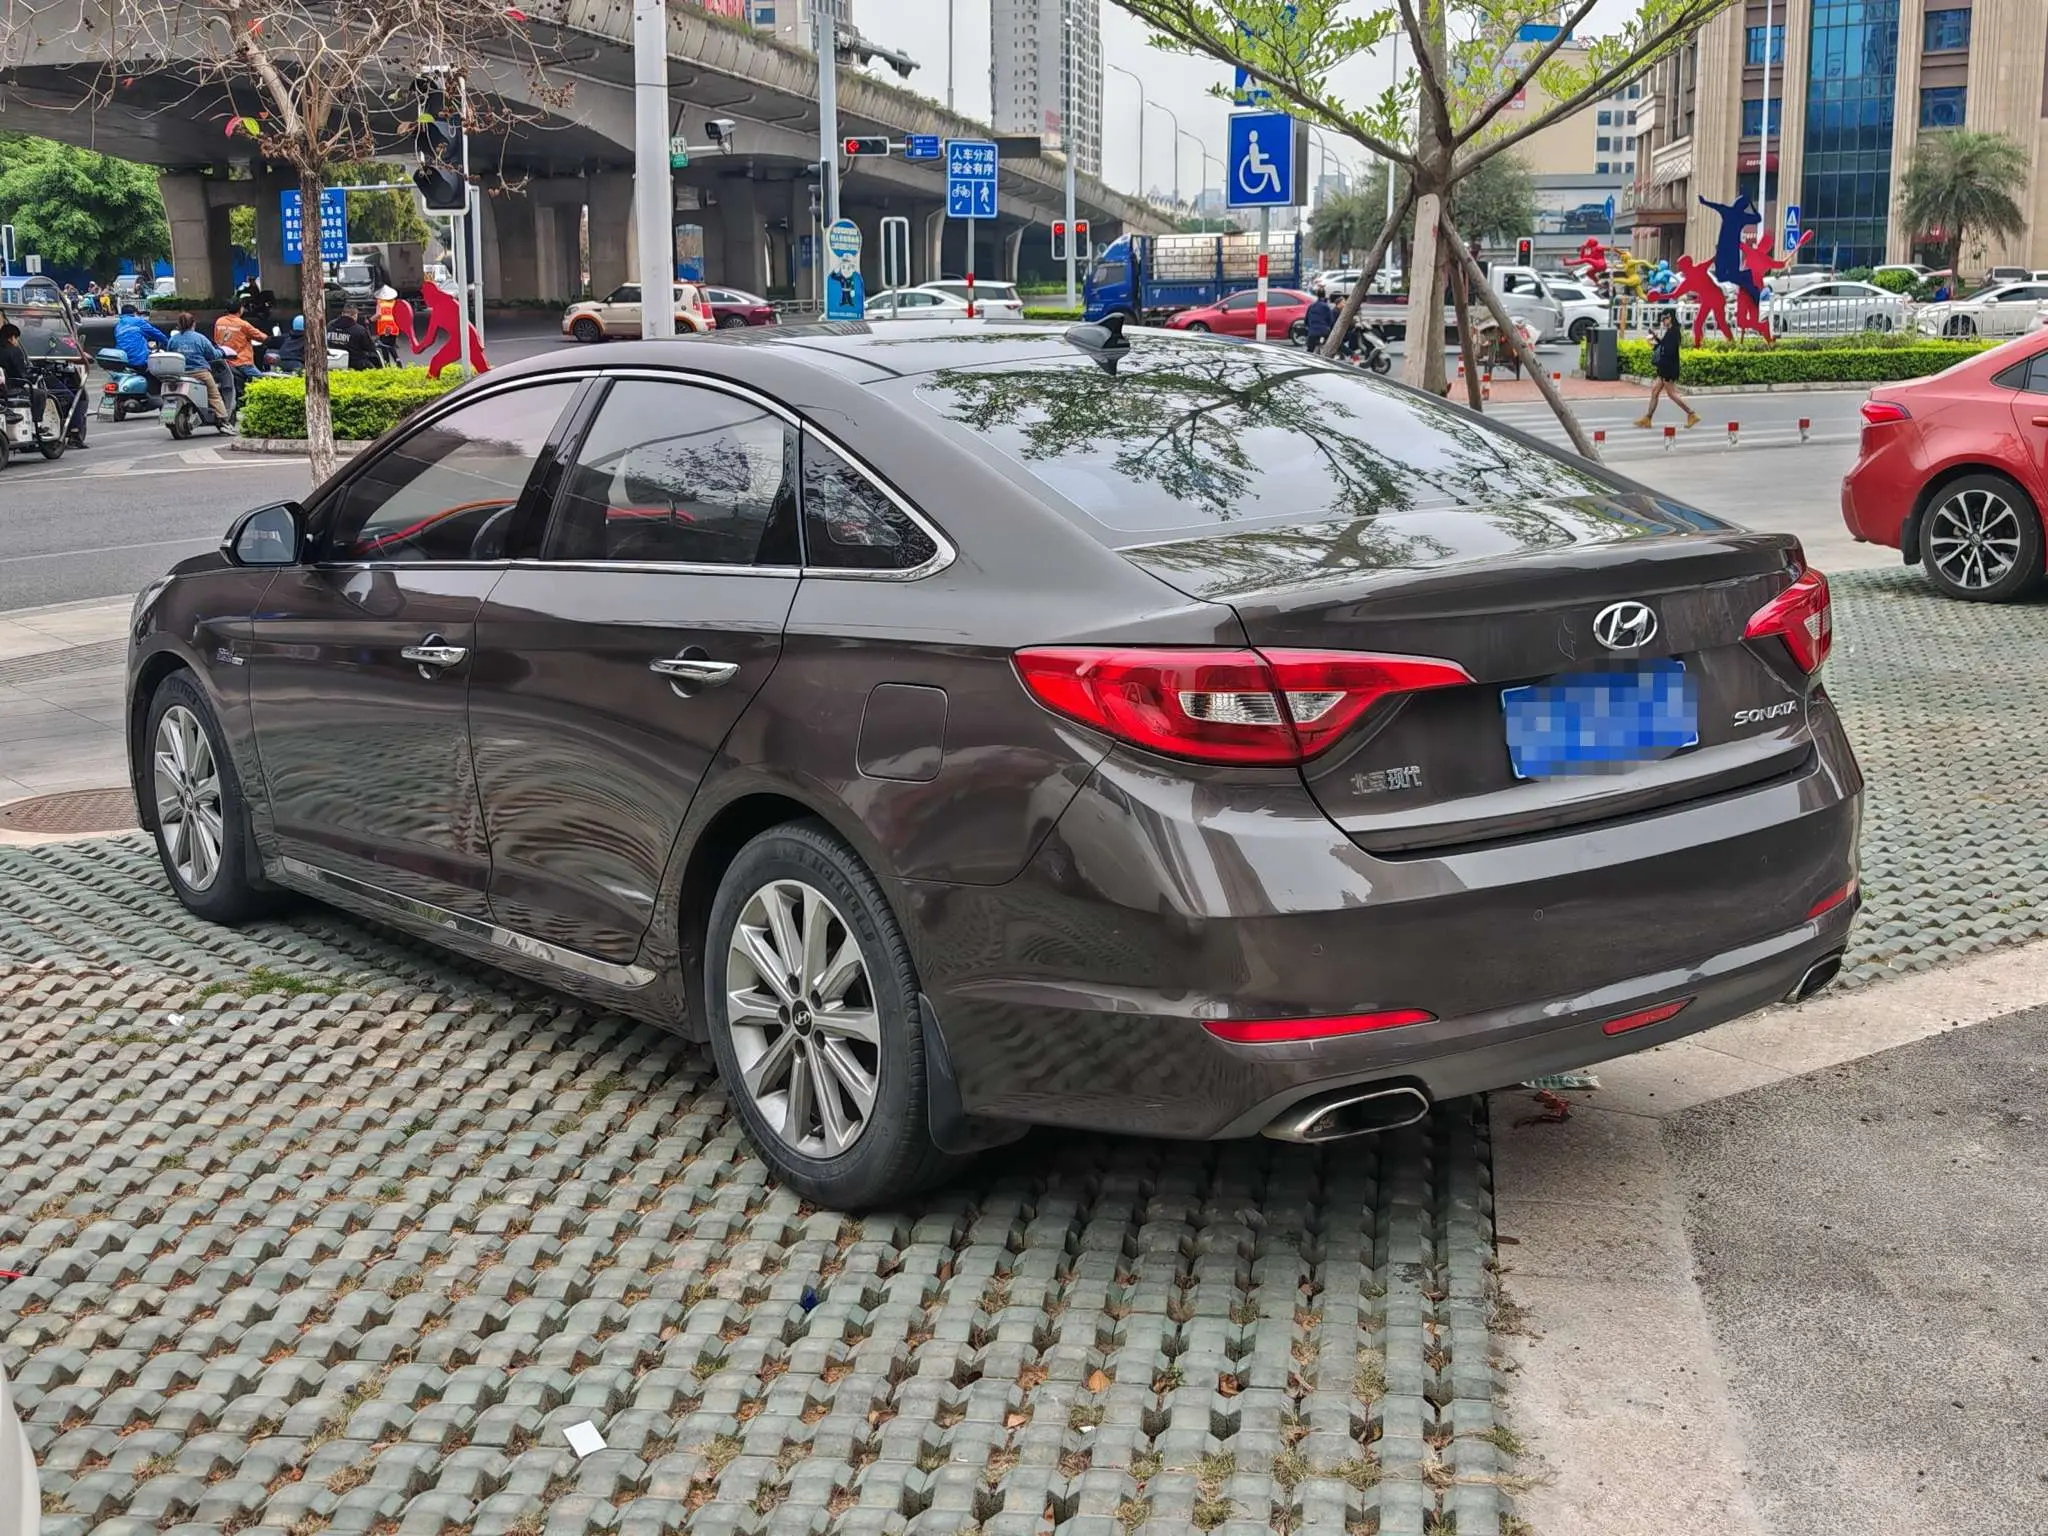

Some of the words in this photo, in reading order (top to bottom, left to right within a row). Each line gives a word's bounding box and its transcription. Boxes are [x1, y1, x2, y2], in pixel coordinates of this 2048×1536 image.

[951, 147, 994, 162] 人车分流
[951, 162, 994, 176] 安全有序
[1733, 699, 1799, 727] SONATA
